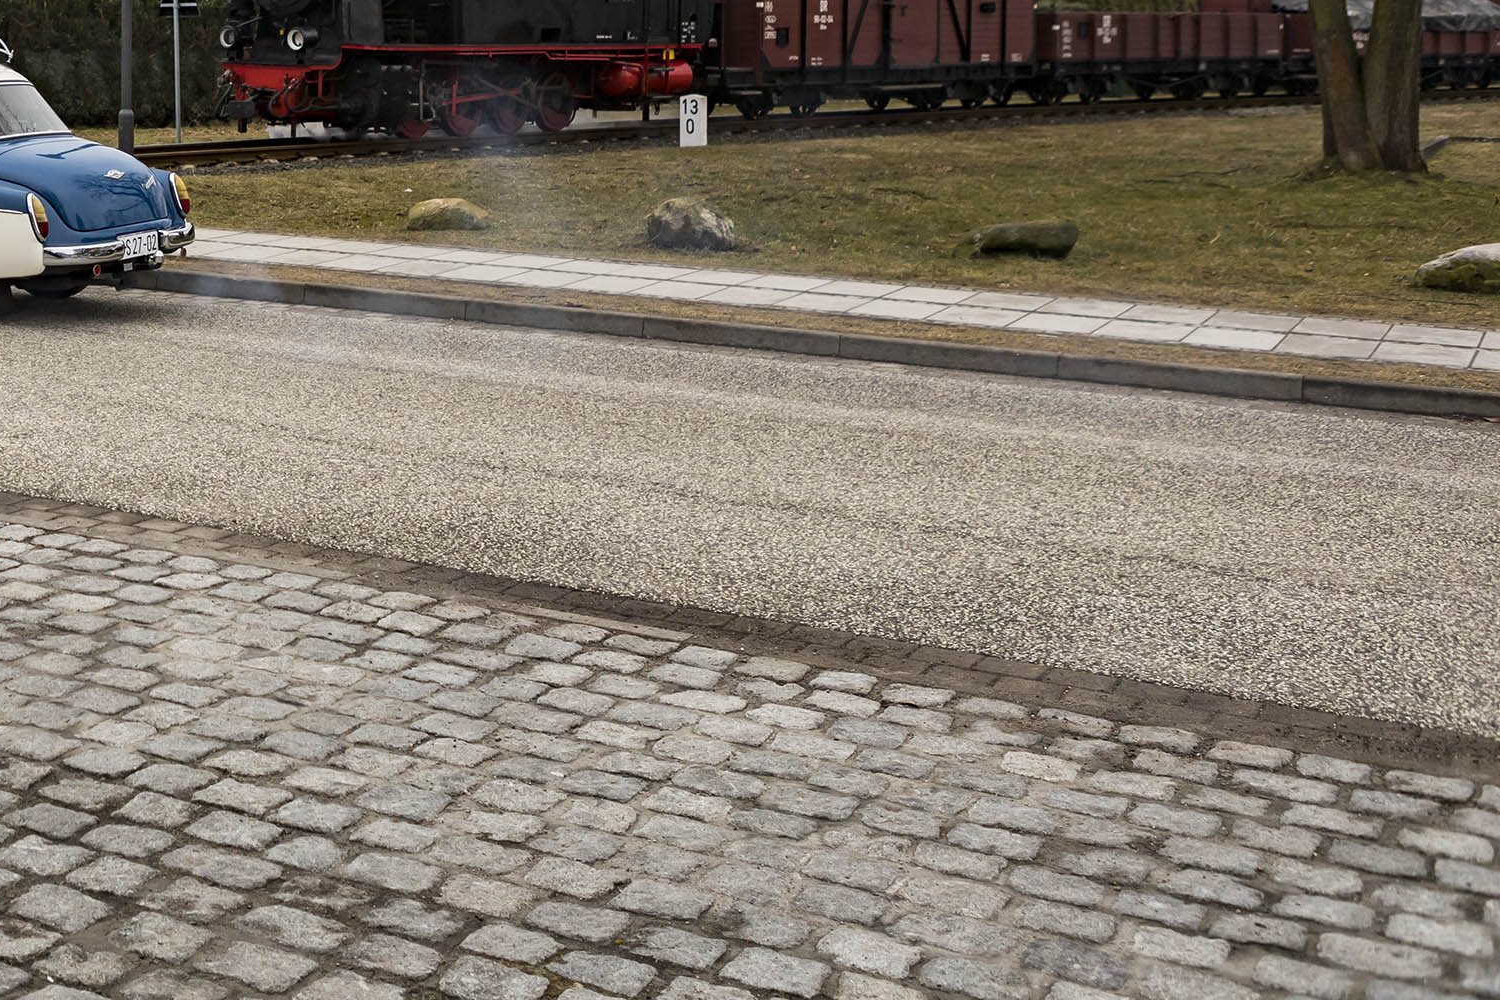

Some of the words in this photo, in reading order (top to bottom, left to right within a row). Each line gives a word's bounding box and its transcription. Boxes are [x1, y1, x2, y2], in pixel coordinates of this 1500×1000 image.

[682, 98, 699, 115] 13
[685, 118, 695, 135] 0
[133, 234, 157, 254] 27-02
